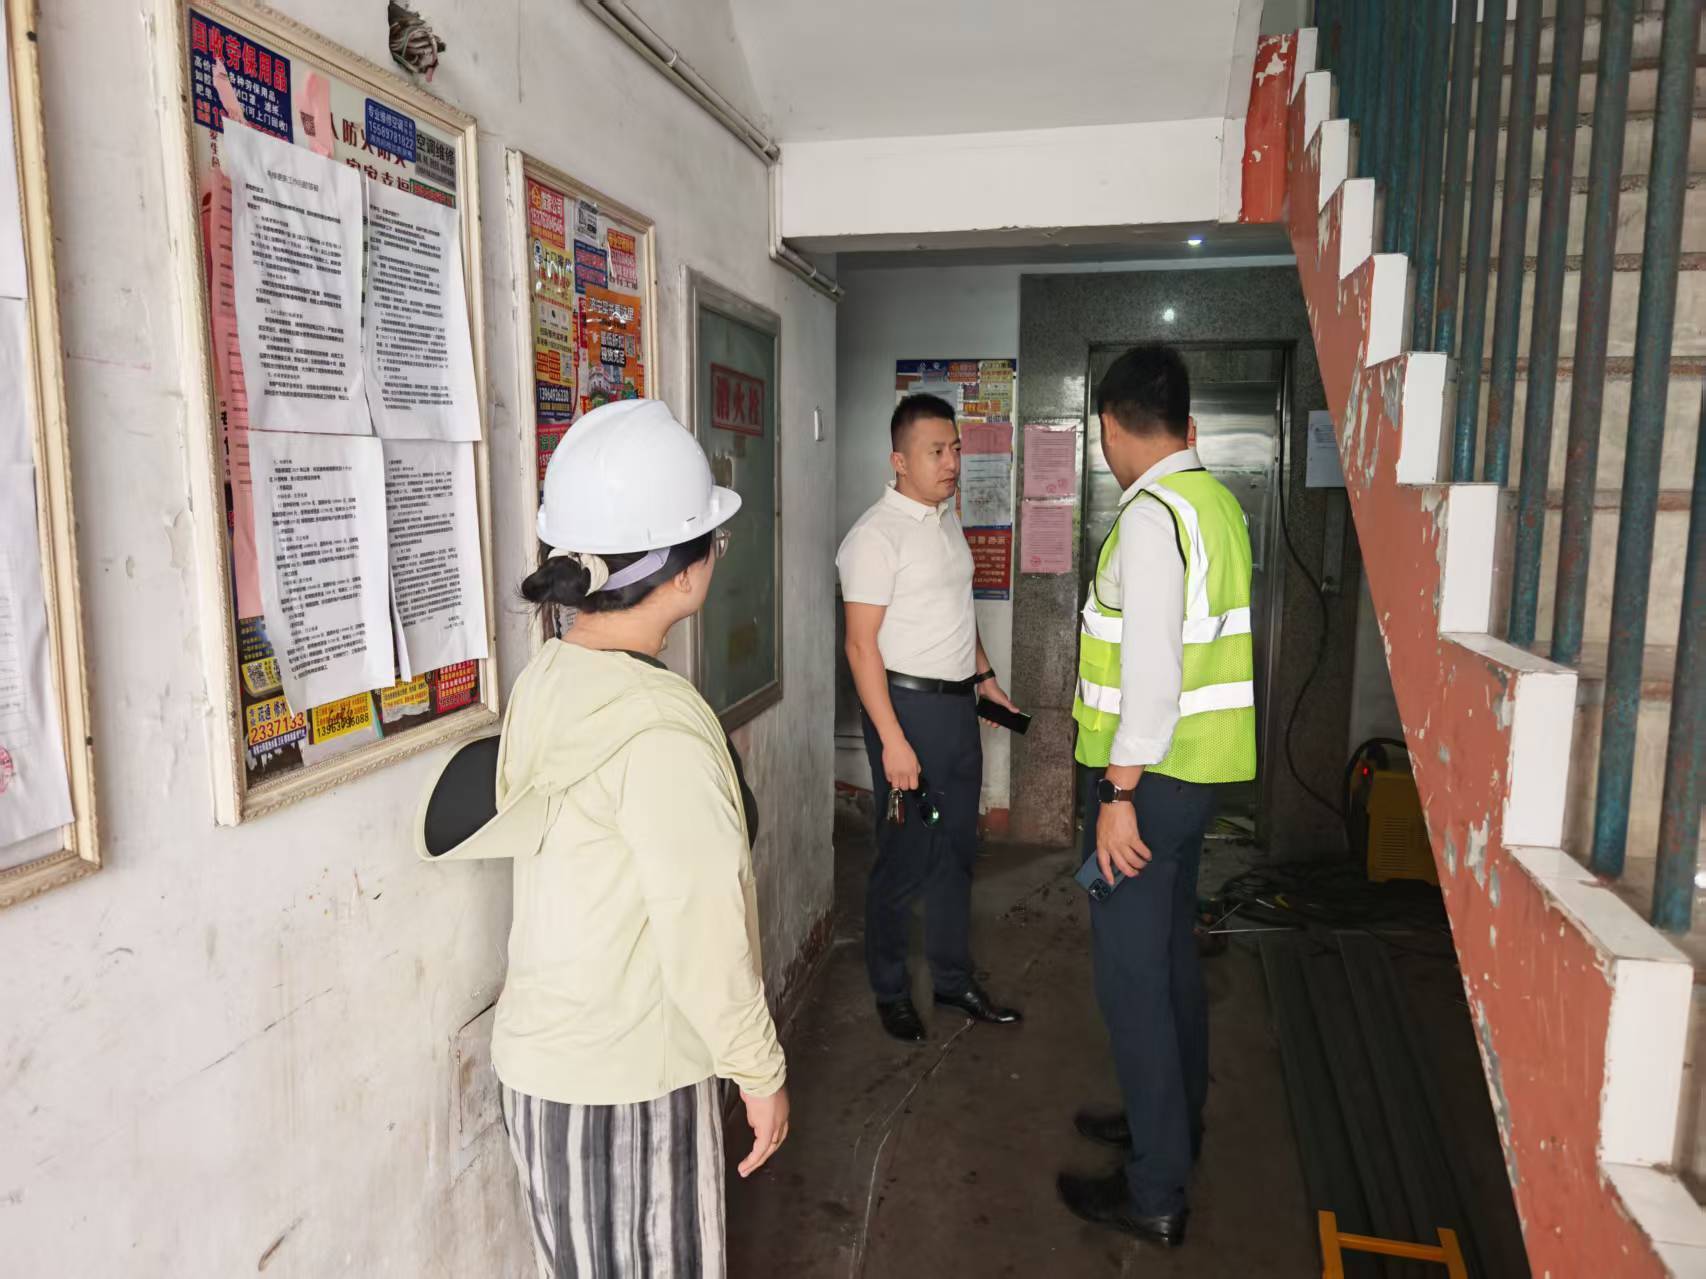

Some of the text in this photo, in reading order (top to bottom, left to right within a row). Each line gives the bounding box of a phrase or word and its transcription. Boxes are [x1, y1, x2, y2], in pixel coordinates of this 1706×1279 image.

[192, 17, 287, 93] 回收劳保用品
[417, 133, 455, 165] 空调维修
